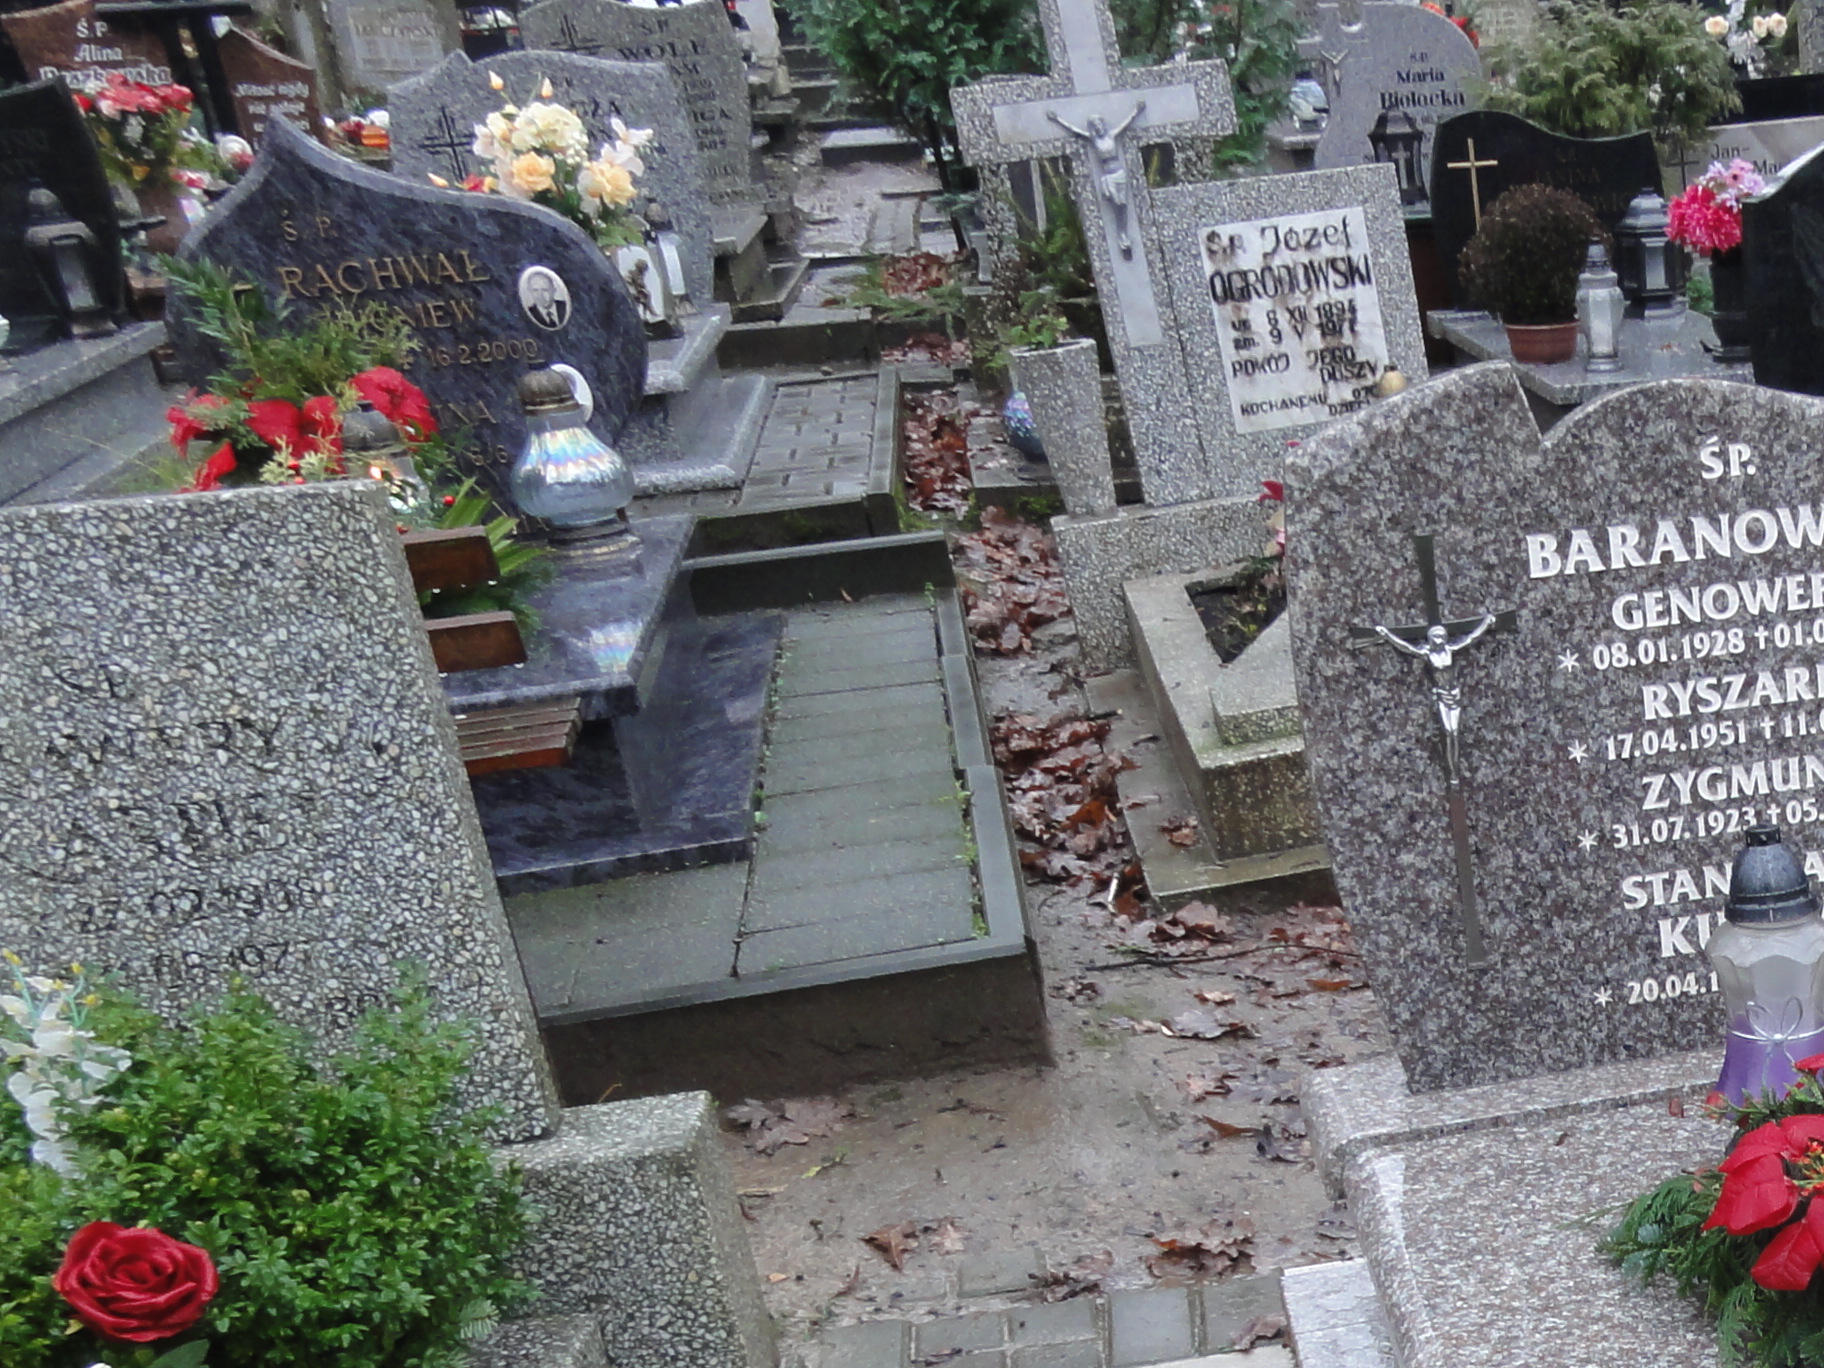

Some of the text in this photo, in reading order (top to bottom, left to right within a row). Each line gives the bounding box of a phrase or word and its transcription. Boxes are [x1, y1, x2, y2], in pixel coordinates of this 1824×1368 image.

[1396, 67, 1445, 84] Maria
[276, 250, 491, 300] RACHWAŁ
[1592, 628, 1746, 671] 08.01.1928
[1606, 720, 1747, 761] 17.04.1951
[1612, 808, 1757, 849] 31.07.1923
